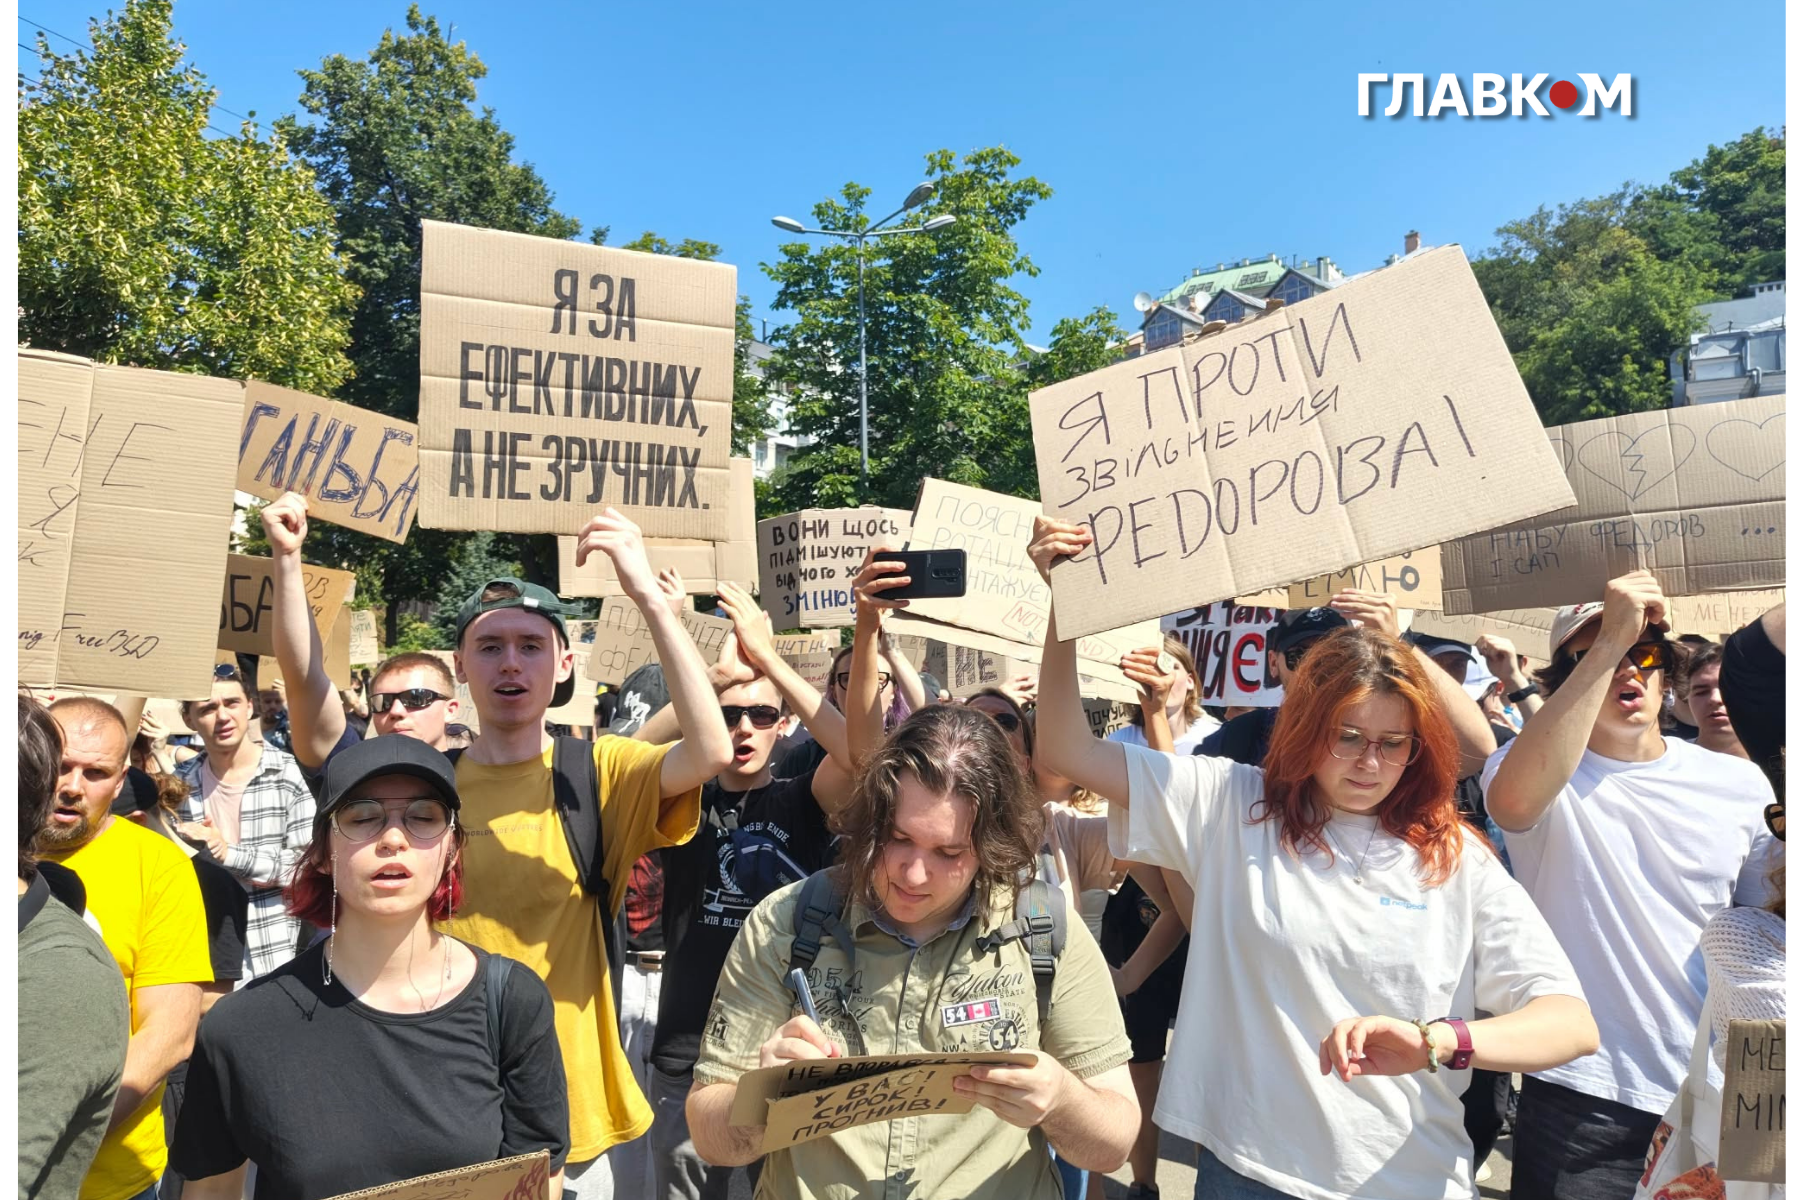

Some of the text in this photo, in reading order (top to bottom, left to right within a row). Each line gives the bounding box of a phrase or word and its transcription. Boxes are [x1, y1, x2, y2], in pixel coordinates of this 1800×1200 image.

[550, 268, 636, 342] Я ЗА
[459, 341, 709, 437] ЕФЕКТИВНИХ,
[1059, 302, 1361, 463] Я ПРОТИ
[239, 401, 419, 536] ГАНЬБА
[449, 428, 710, 510] А НЕ ЗРУЧНИХ.
[772, 519, 899, 546] ВОНИ ЩОСЬ
[1491, 521, 1567, 551] НАБУ
[1590, 515, 1705, 553] ФЕДОРОВ
[1514, 552, 1560, 575] САП
[776, 572, 796, 591] ВІД
[946, 1007, 967, 1023] 54
[992, 1026, 1016, 1049] 54
[788, 1066, 825, 1081] НЕ
[814, 1091, 836, 1108] У
[792, 1098, 947, 1141] ПРОГНИВ!
